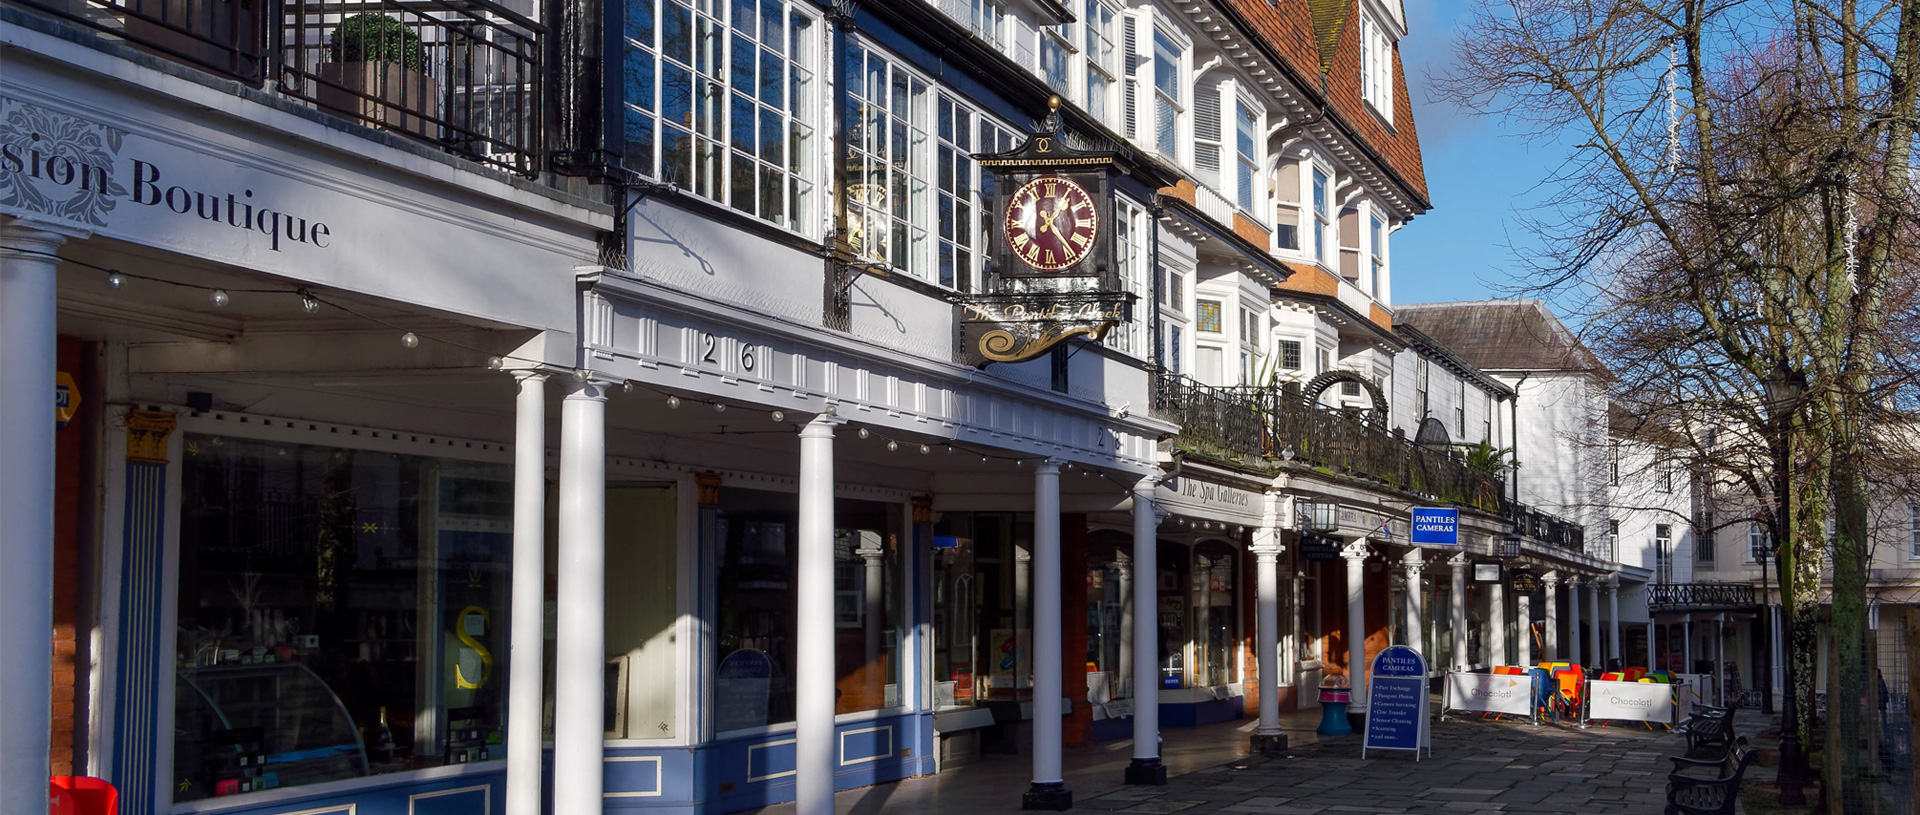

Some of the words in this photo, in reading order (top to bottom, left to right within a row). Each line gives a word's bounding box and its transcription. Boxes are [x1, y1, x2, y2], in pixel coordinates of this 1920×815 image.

[1, 132, 110, 196] sion
[129, 157, 331, 253] Boutique
[1077, 301, 1121, 319] Clock
[1182, 477, 1197, 498] The
[1199, 480, 1215, 504] Spa
[1217, 484, 1249, 507] Galleries
[1415, 515, 1456, 524] PANTILES
[1416, 524, 1454, 532] CAMERAS
[1382, 657, 1416, 665] PANTILES
[1382, 664, 1414, 672] CAMERAS
